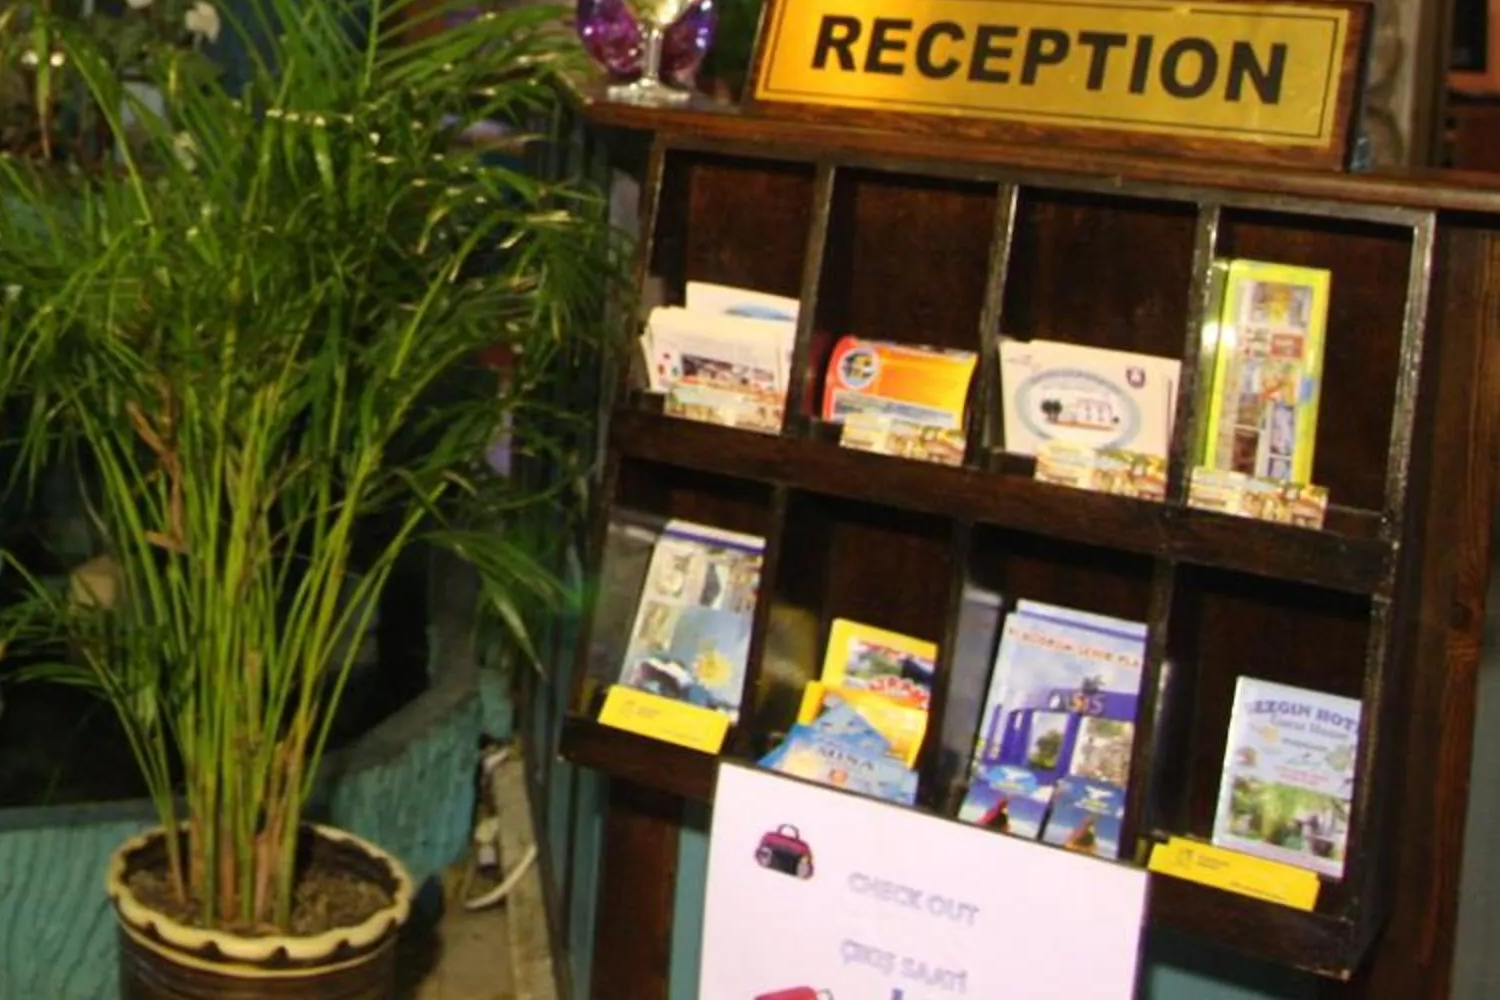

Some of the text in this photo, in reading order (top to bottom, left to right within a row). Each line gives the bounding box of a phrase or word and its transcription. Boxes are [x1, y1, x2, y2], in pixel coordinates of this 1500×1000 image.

[811, 14, 1288, 105] RECEPTION
[847, 871, 980, 927] CHECK OUT
